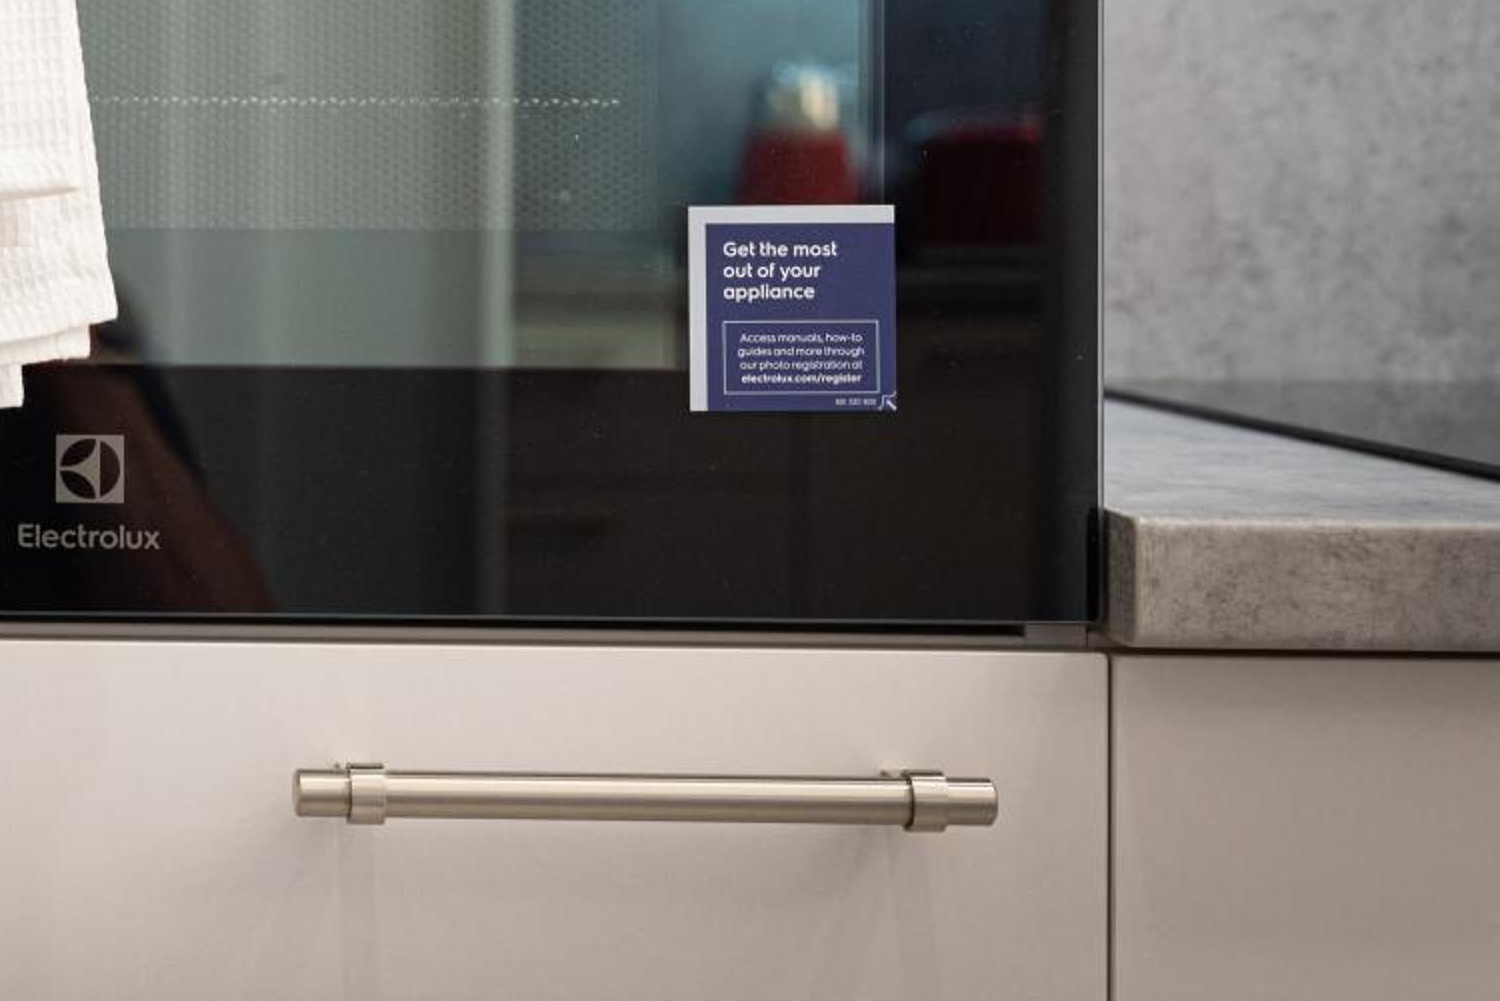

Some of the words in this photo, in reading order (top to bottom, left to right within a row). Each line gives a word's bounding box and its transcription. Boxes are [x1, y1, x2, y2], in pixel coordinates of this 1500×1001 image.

[723, 241, 755, 257] Get
[759, 241, 788, 257] the
[793, 241, 838, 257] most
[723, 264, 752, 278] out
[757, 263, 775, 278] of
[779, 264, 821, 282] your
[723, 284, 816, 303] appliance
[740, 333, 776, 343] Access
[778, 333, 823, 344] manuals,
[825, 333, 863, 343] how-to
[737, 346, 772, 358] guides
[774, 346, 794, 356] and
[796, 347, 822, 356] more
[824, 346, 864, 358] through
[740, 361, 757, 370] our
[759, 360, 790, 372] photo
[792, 360, 850, 371] registration
[852, 360, 863, 370] at
[741, 373, 862, 385] electrolux.com/register
[17, 522, 161, 549] Electrolux
